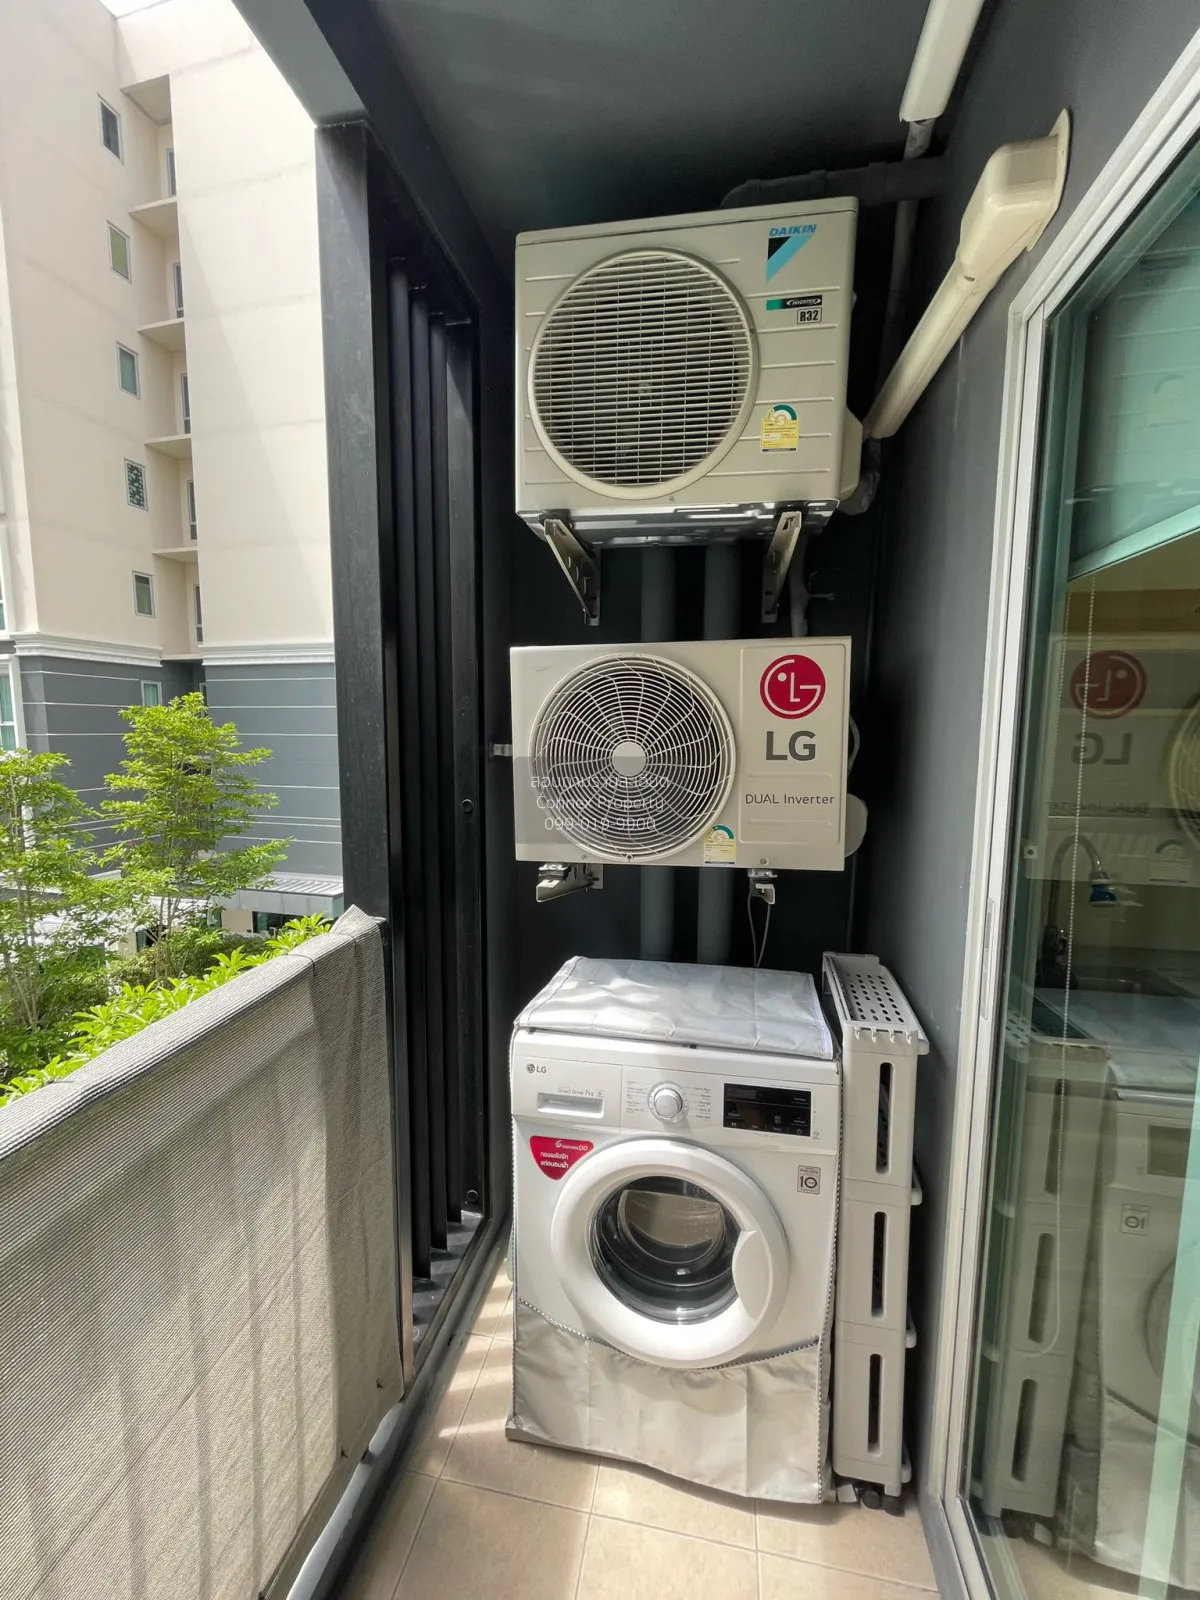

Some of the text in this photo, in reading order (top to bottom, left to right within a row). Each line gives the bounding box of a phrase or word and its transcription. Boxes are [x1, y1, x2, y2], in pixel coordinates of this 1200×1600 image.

[769, 224, 817, 237] DAIKIN
[799, 310, 819, 322] R32
[765, 730, 816, 761] LG
[745, 793, 835, 805] DUAL Inverter
[536, 1065, 547, 1074] LG
[800, 1175, 818, 1189] 10
